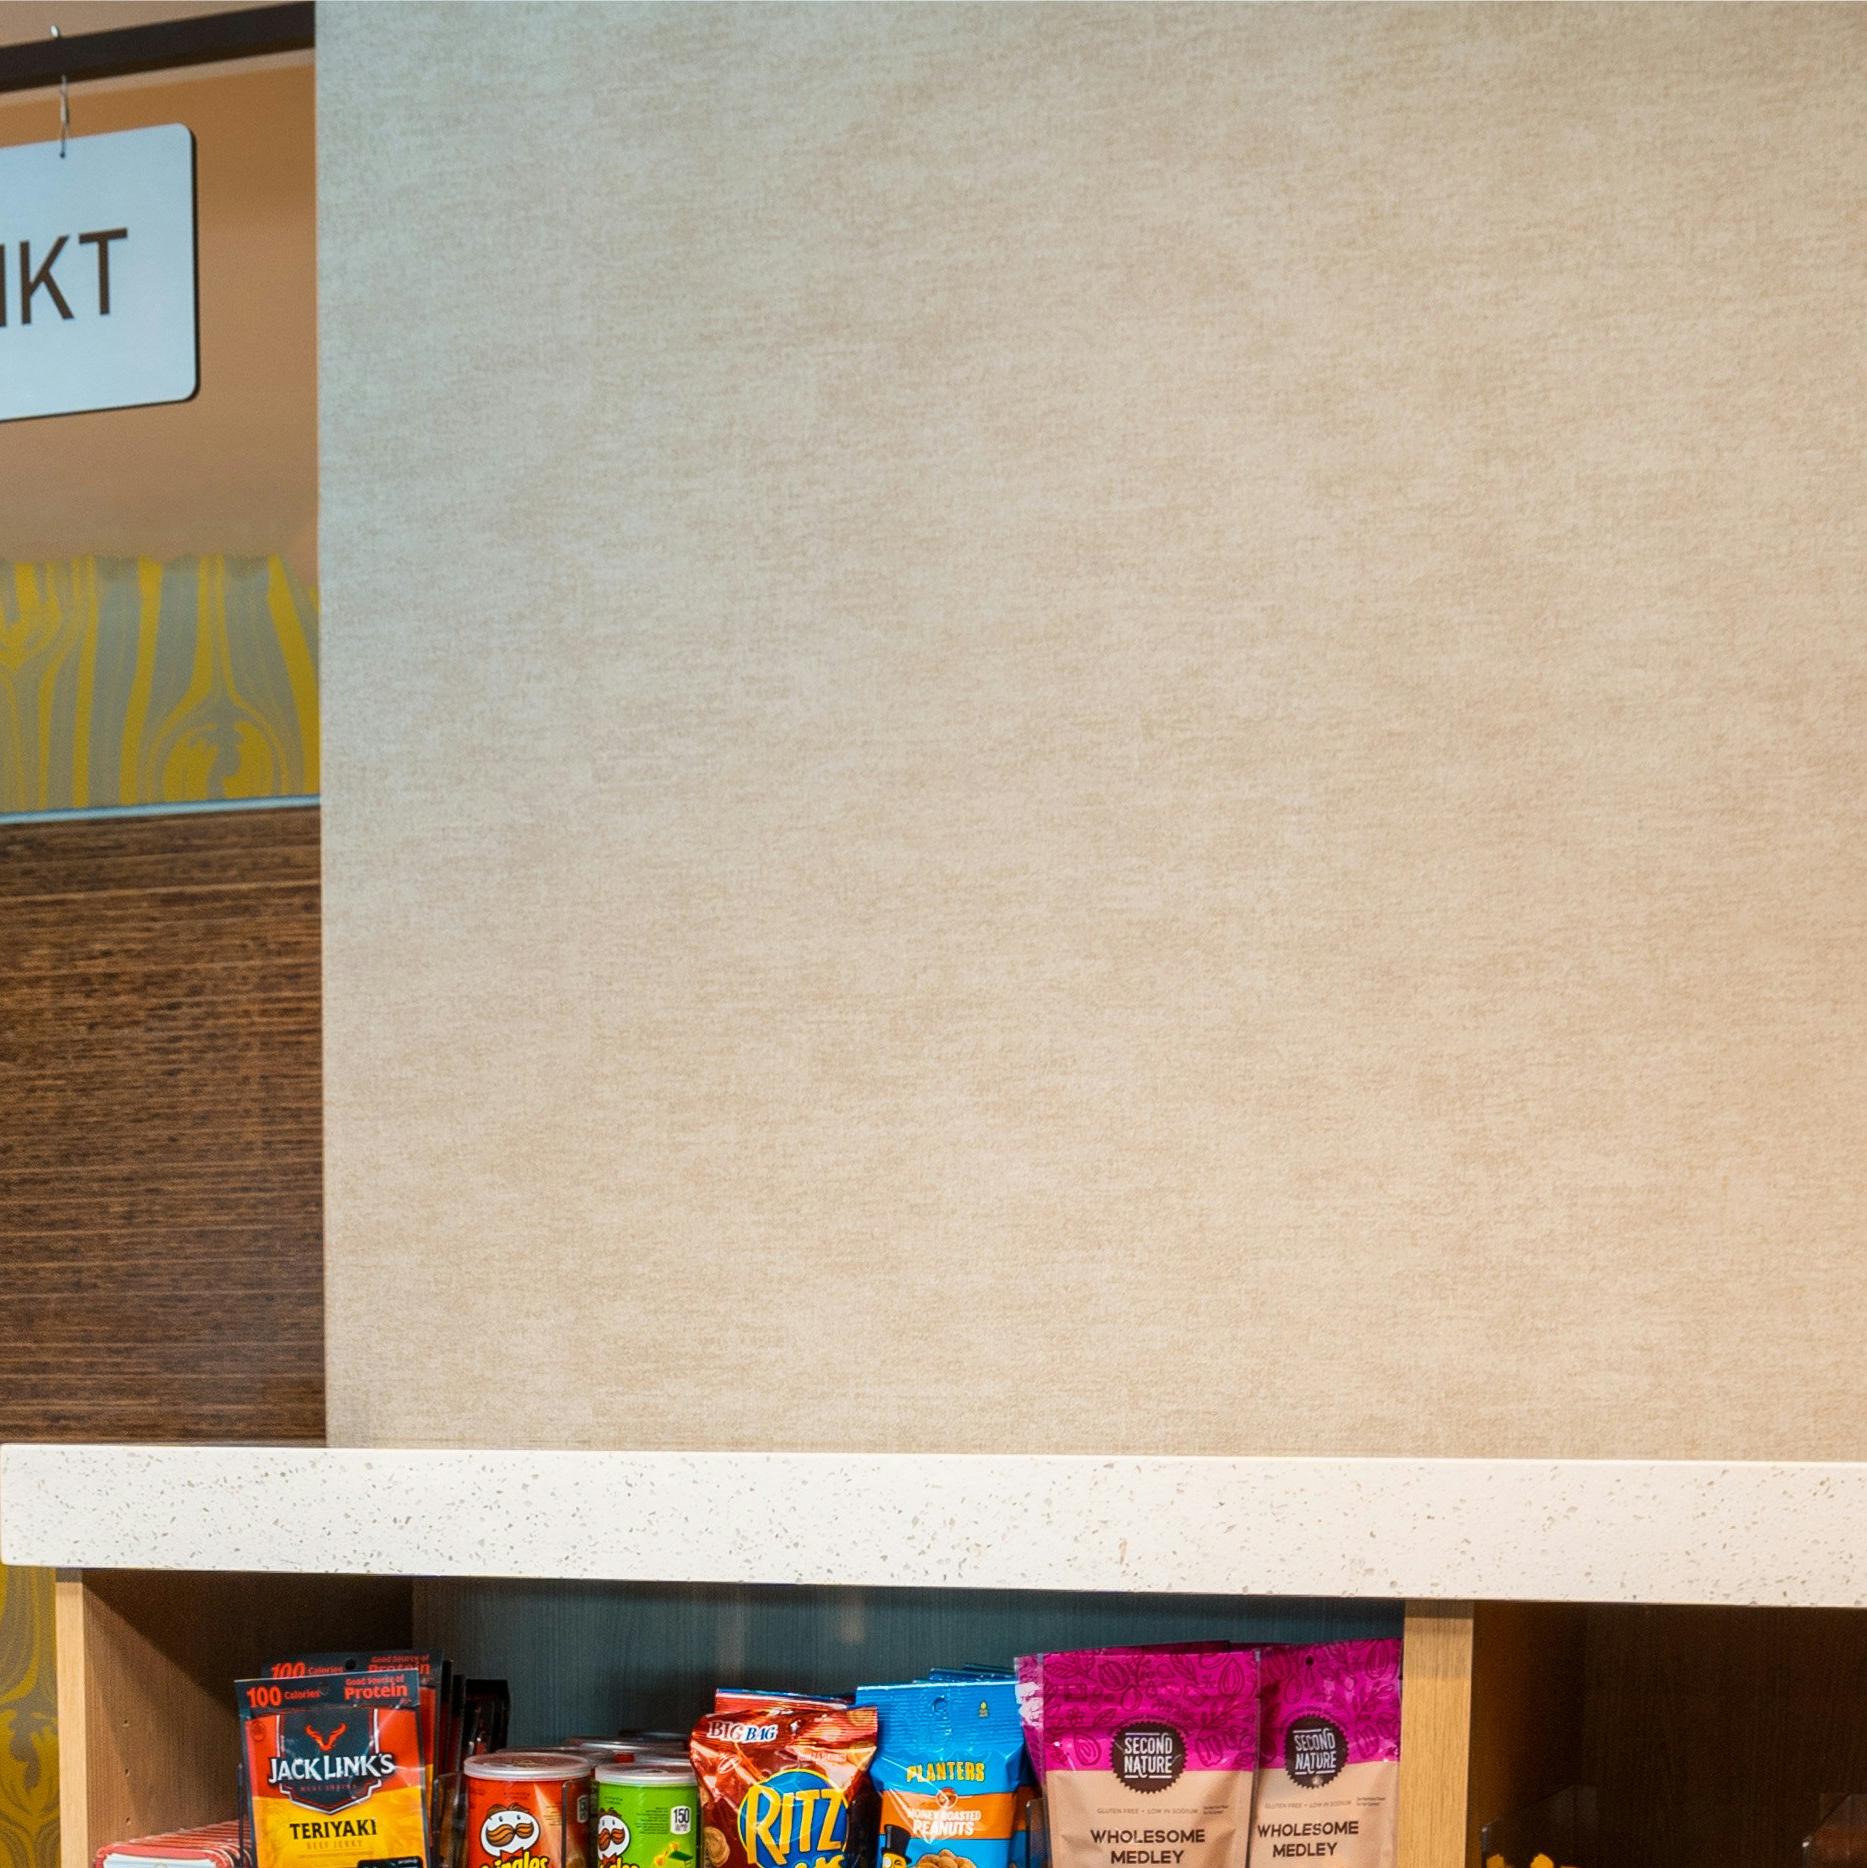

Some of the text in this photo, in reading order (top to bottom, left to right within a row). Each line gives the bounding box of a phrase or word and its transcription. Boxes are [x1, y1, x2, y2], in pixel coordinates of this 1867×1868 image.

[247, 1685, 320, 1707] 100 Calories
[344, 1683, 407, 1700] Protein
[1125, 1732, 1172, 1753] SECOND
[1295, 1728, 1335, 1750] SECOND
[269, 1754, 395, 1784] JACK LINK'S
[906, 1761, 984, 1782] PLANTERS
[1124, 1756, 1172, 1778] NATURE
[1295, 1751, 1336, 1774] NATURE
[290, 1819, 376, 1839] TERIYAKI
[744, 1786, 842, 1865] RITZ
[1090, 1829, 1205, 1843] WHOLESOME
[1258, 1821, 1359, 1837] WHOLESOME
[307, 1841, 329, 1850] BEEF
[1272, 1843, 1337, 1857] MEDLEY
[1111, 1851, 1184, 1863] MEDLEY
